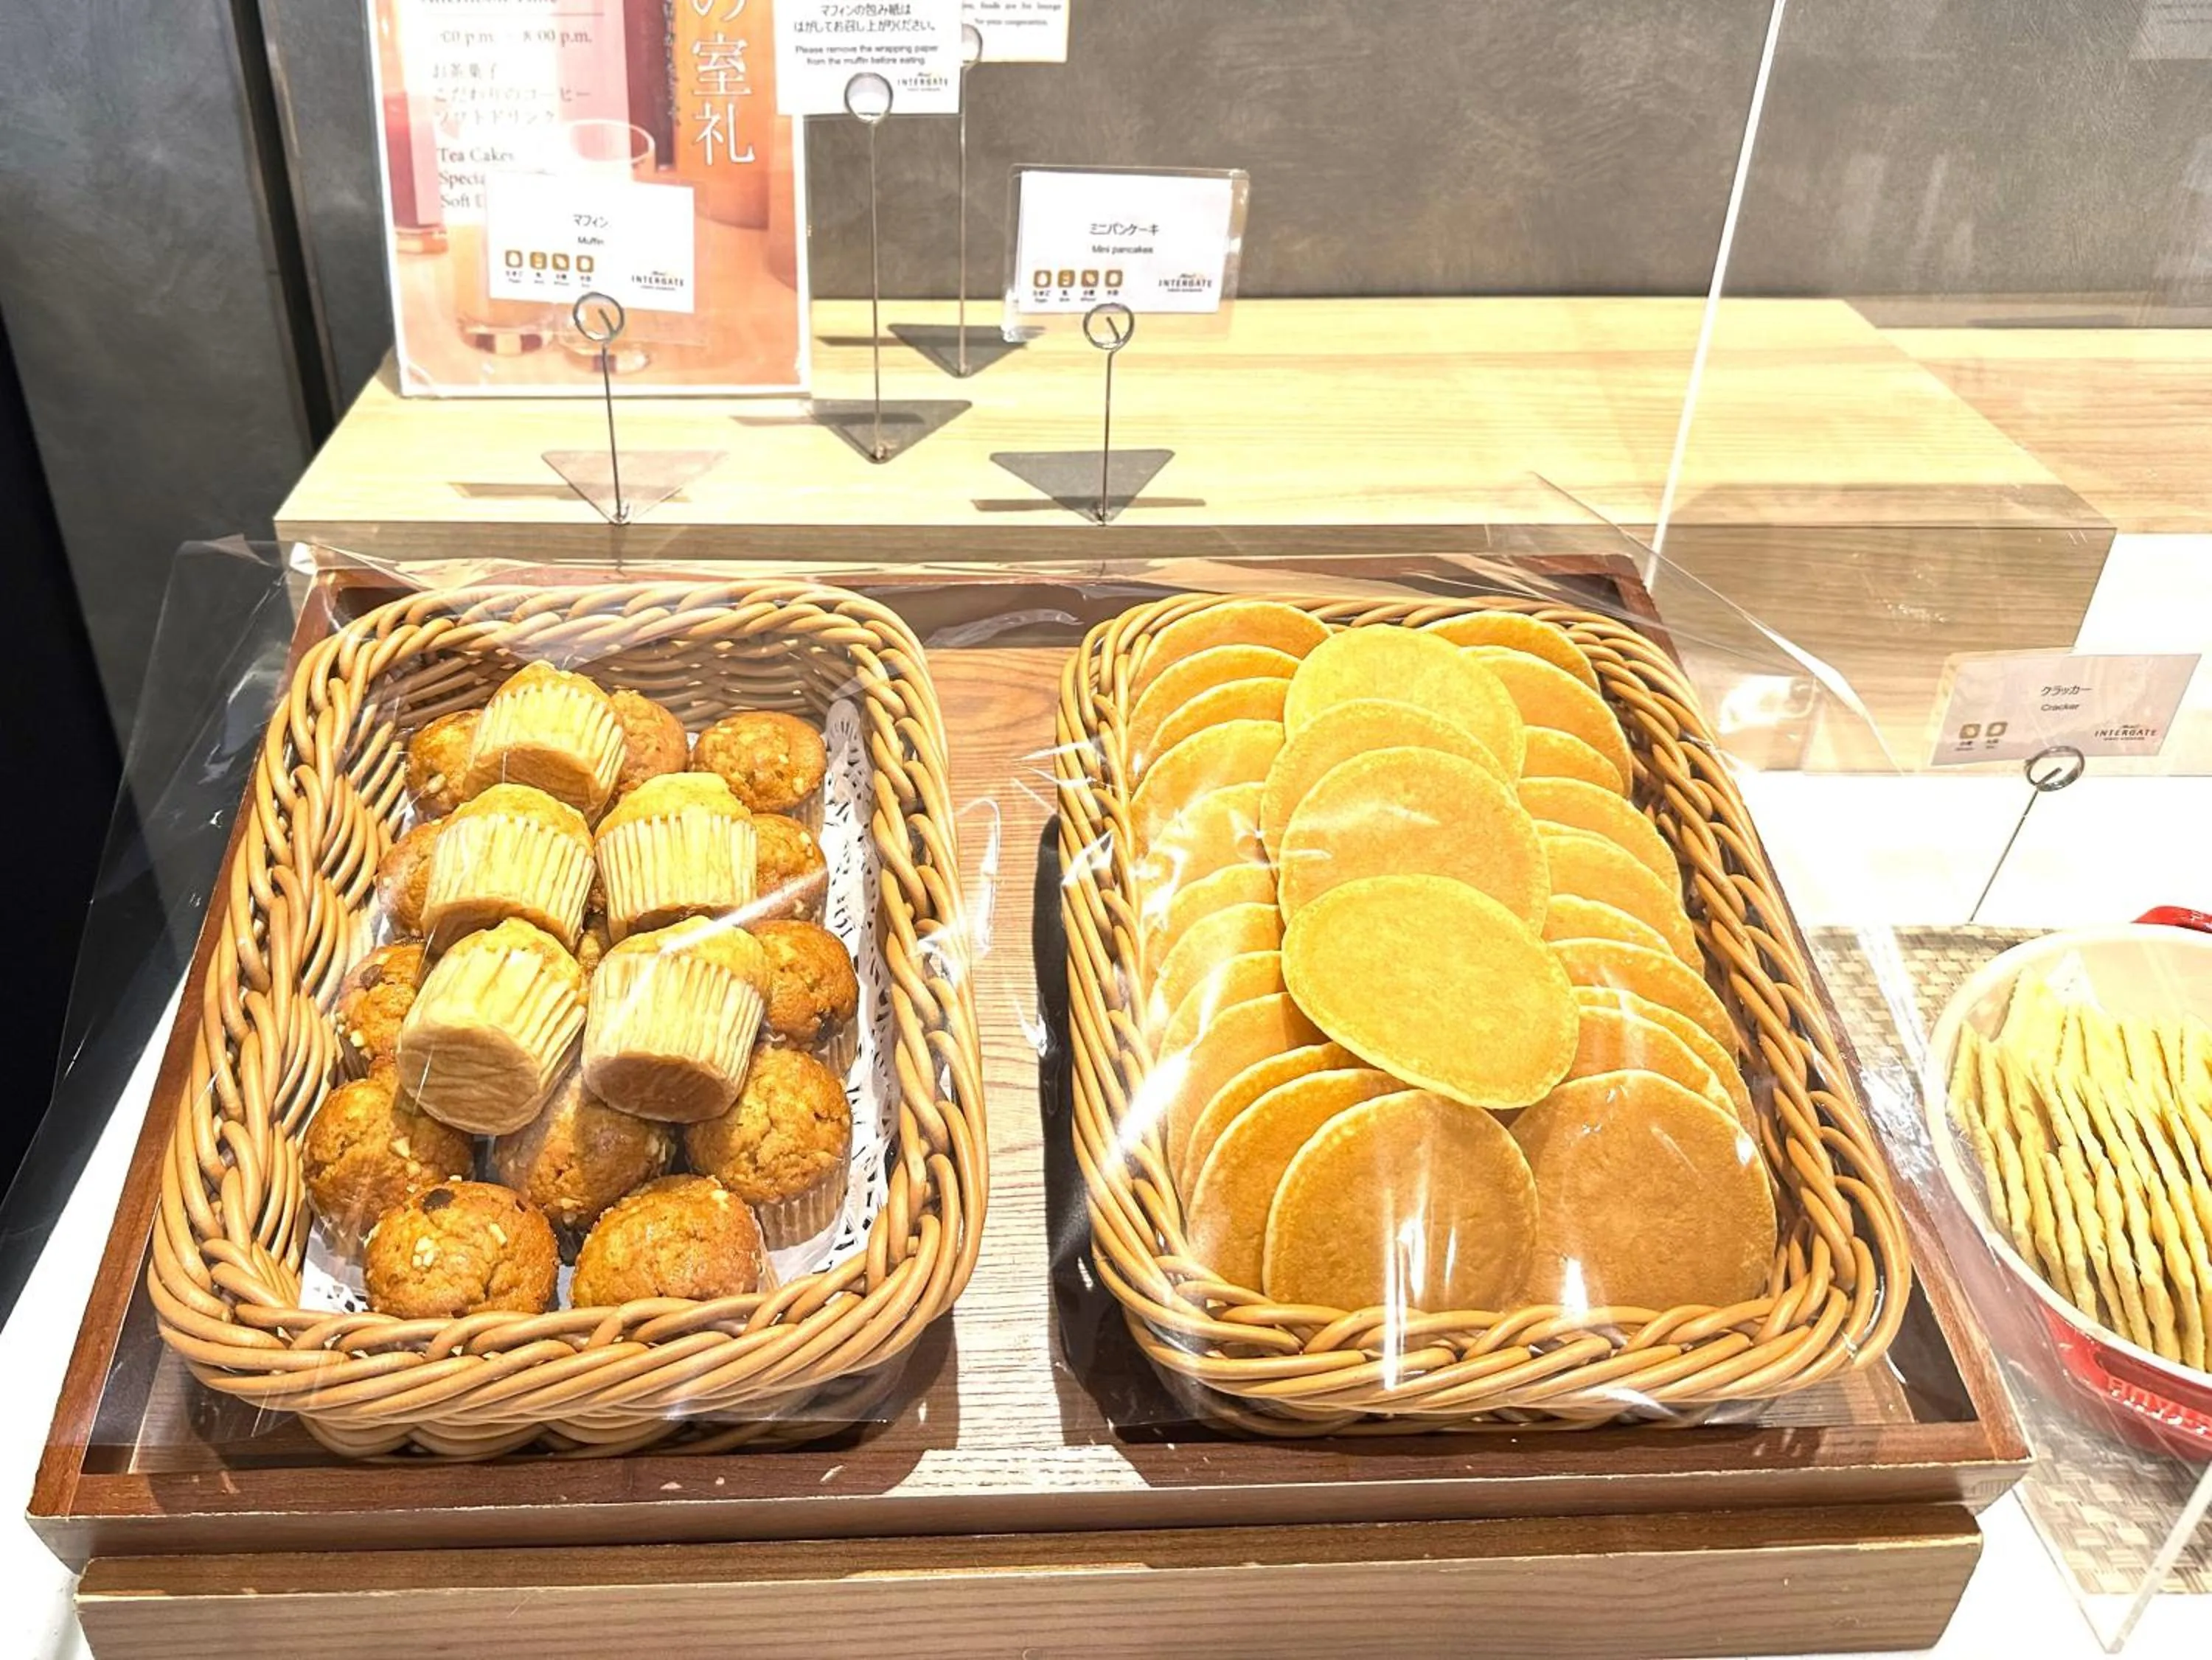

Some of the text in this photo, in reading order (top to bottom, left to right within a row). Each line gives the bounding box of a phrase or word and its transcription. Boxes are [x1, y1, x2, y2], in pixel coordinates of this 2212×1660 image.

[795, 46, 824, 54] Please
[874, 46, 911, 54] wrapping
[914, 46, 939, 54] paper
[437, 147, 465, 162] Tea
[574, 214, 608, 228] マフィン
[1089, 223, 1160, 236] ミニパンケーキ
[577, 236, 605, 245] Muffin
[1092, 245, 1153, 255] Mini pancakes
[2041, 686, 2093, 696] クラッカー
[2095, 729, 2157, 737] INTERGATE
